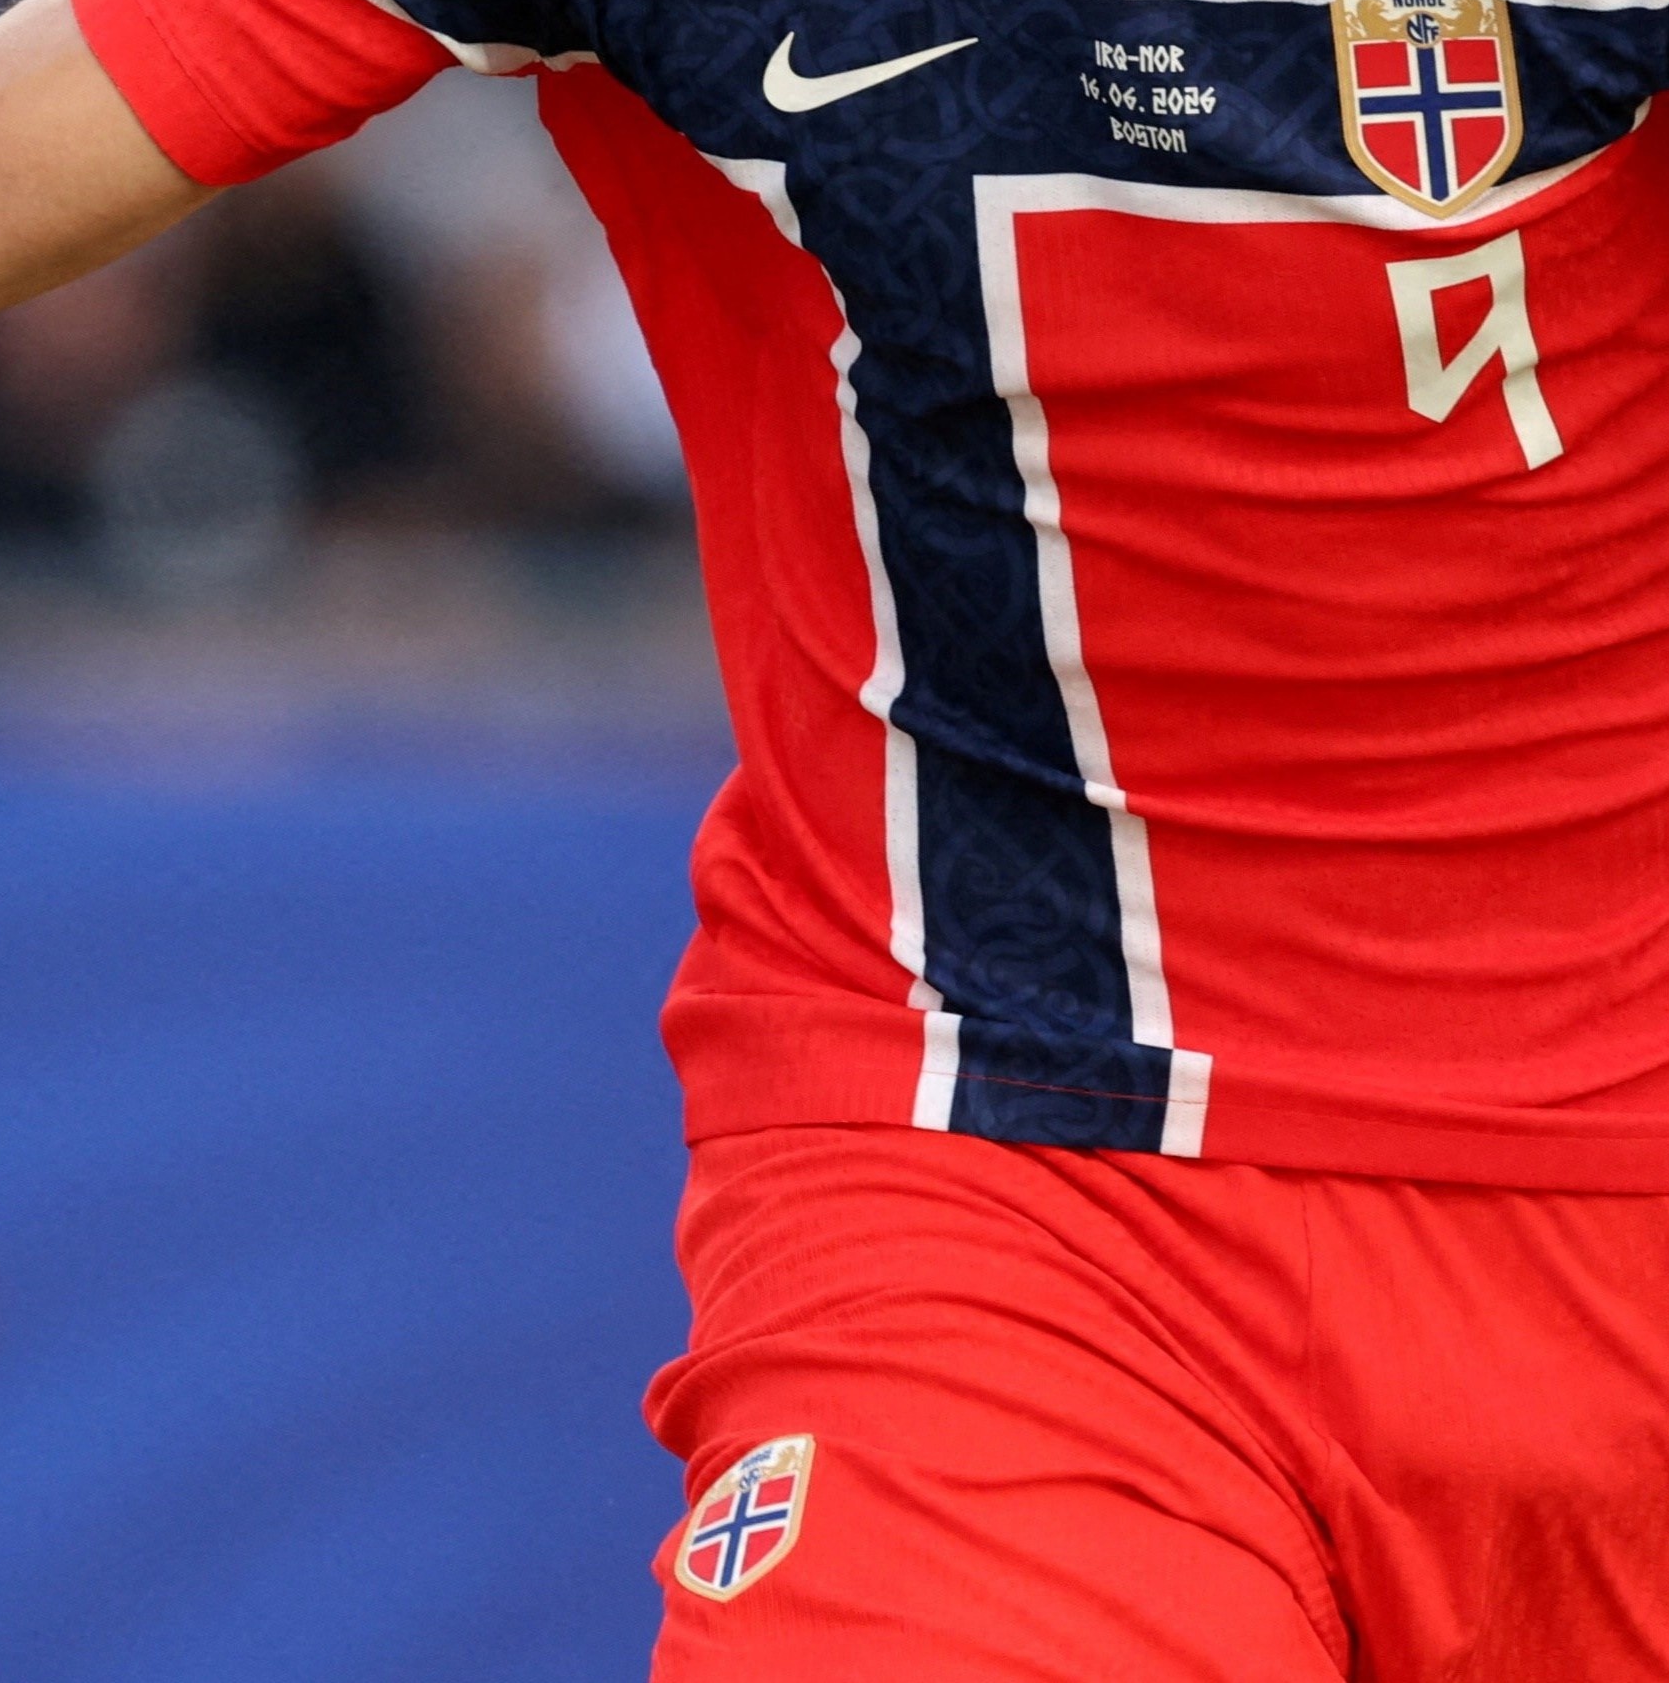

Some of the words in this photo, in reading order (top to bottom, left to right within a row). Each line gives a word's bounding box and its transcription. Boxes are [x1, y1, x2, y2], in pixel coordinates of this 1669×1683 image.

[1095, 40, 1185, 73] IRQ-NOR
[1110, 116, 1187, 153] BOSTON
[1385, 230, 1563, 470] 9
